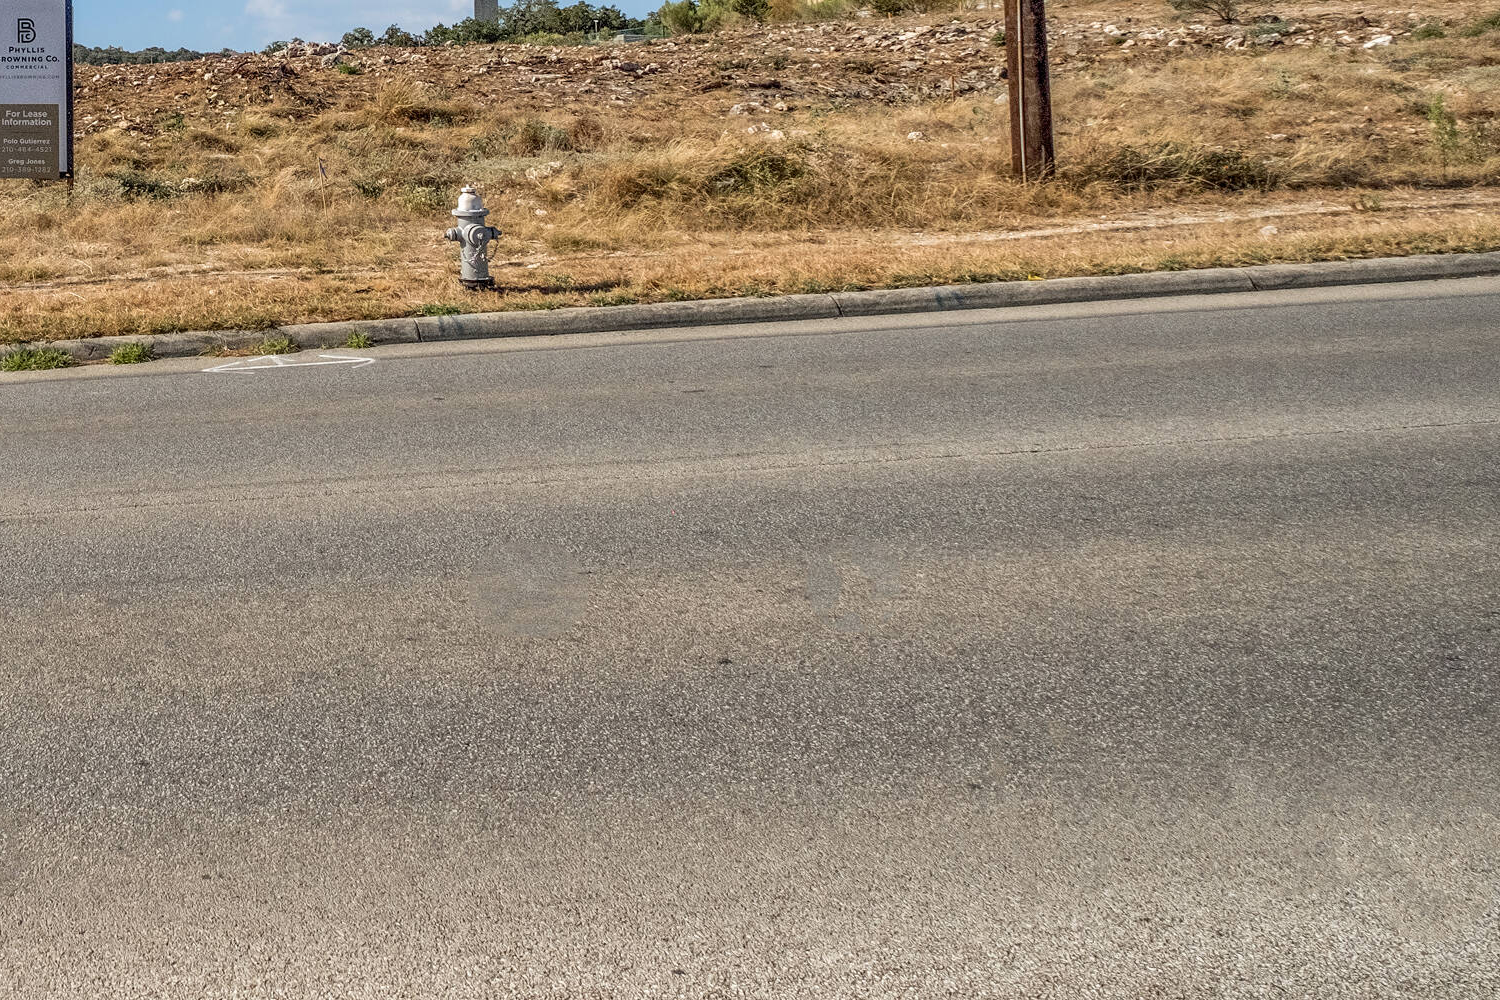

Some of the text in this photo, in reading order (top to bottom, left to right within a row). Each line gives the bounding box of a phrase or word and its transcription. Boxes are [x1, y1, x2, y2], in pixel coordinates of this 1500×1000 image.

[5, 110, 48, 118] For Lease
[1, 118, 52, 126] Information
[8, 158, 25, 166] Greg
